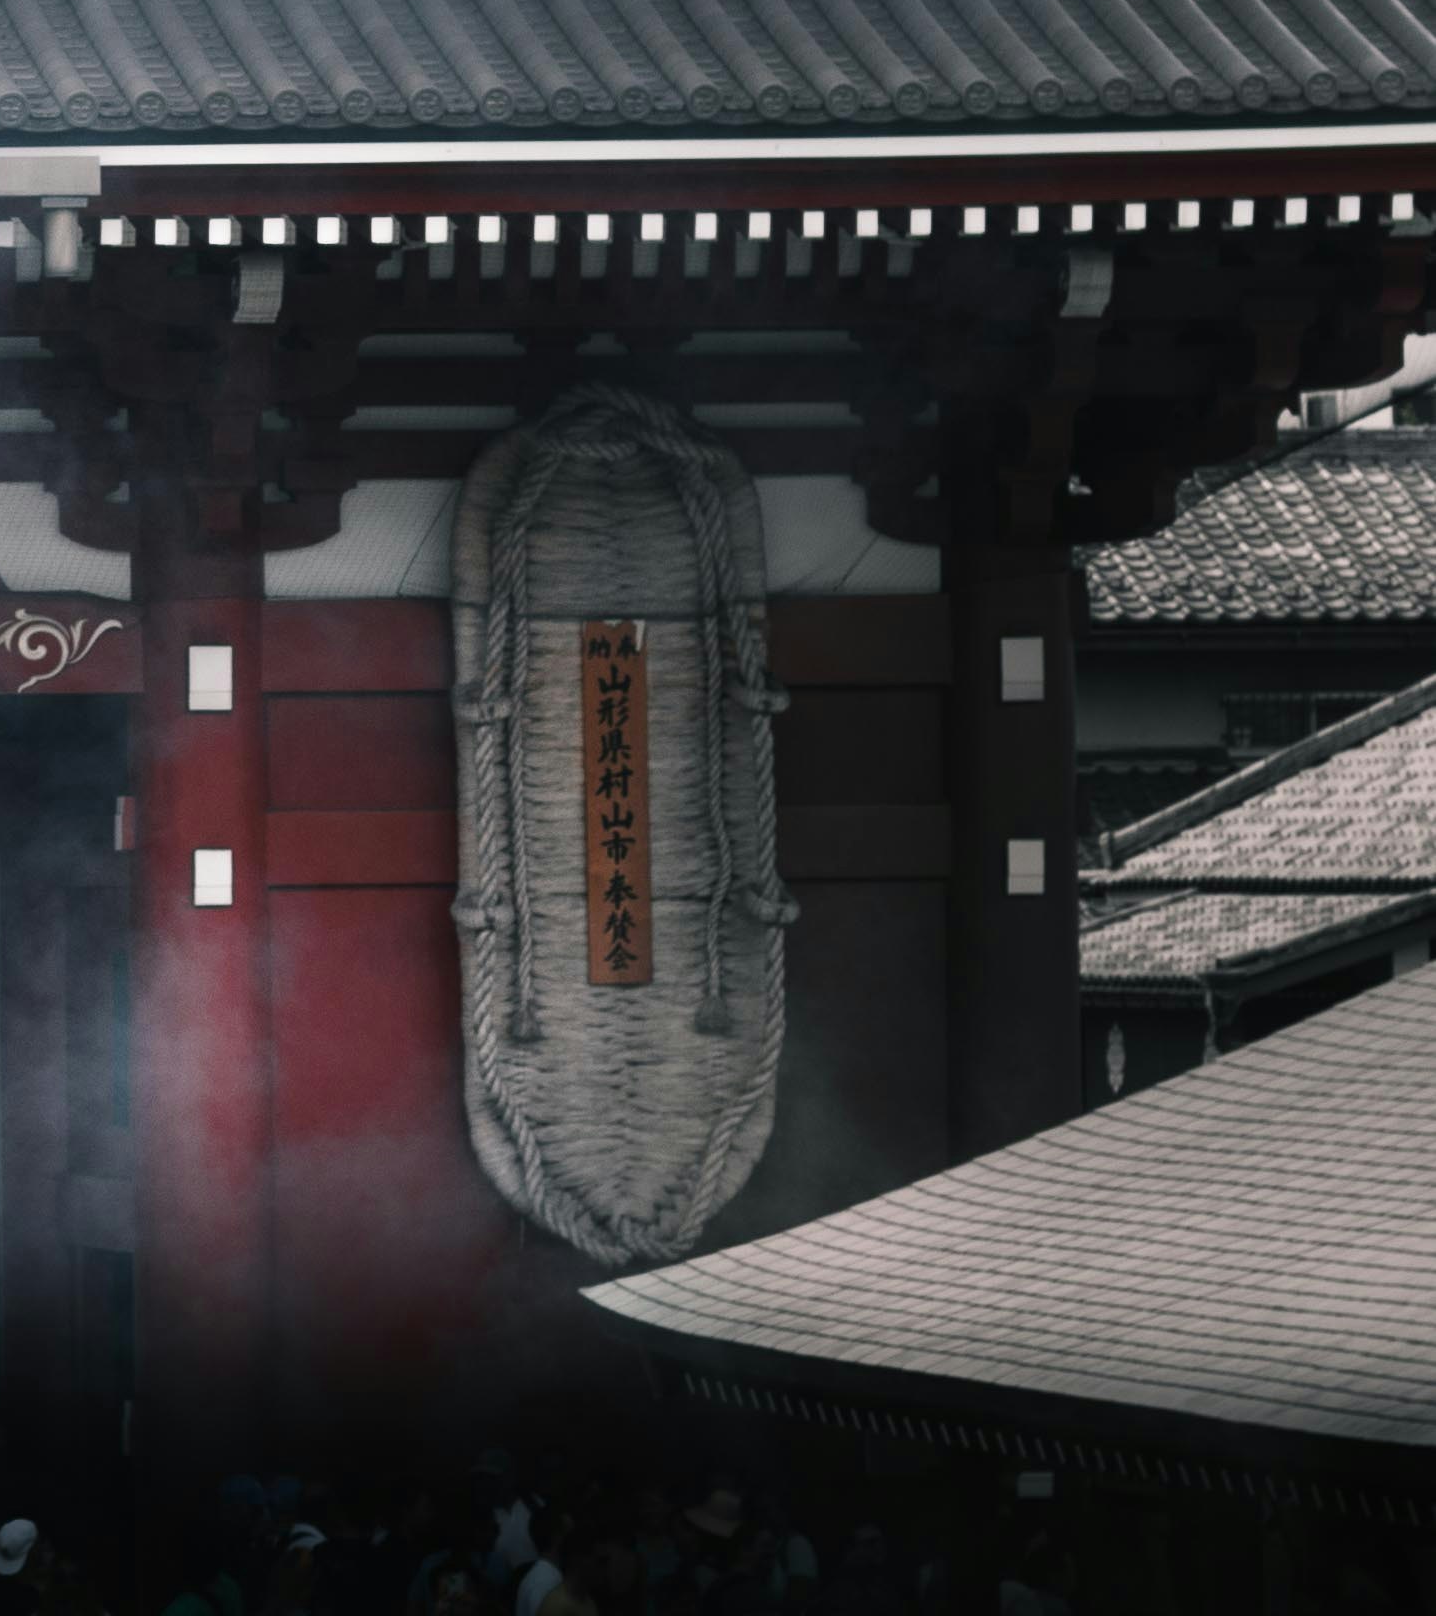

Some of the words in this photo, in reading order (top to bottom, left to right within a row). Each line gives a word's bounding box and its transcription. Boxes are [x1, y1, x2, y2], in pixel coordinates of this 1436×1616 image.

[595, 665, 639, 972] 山形県村山市奉賛会
